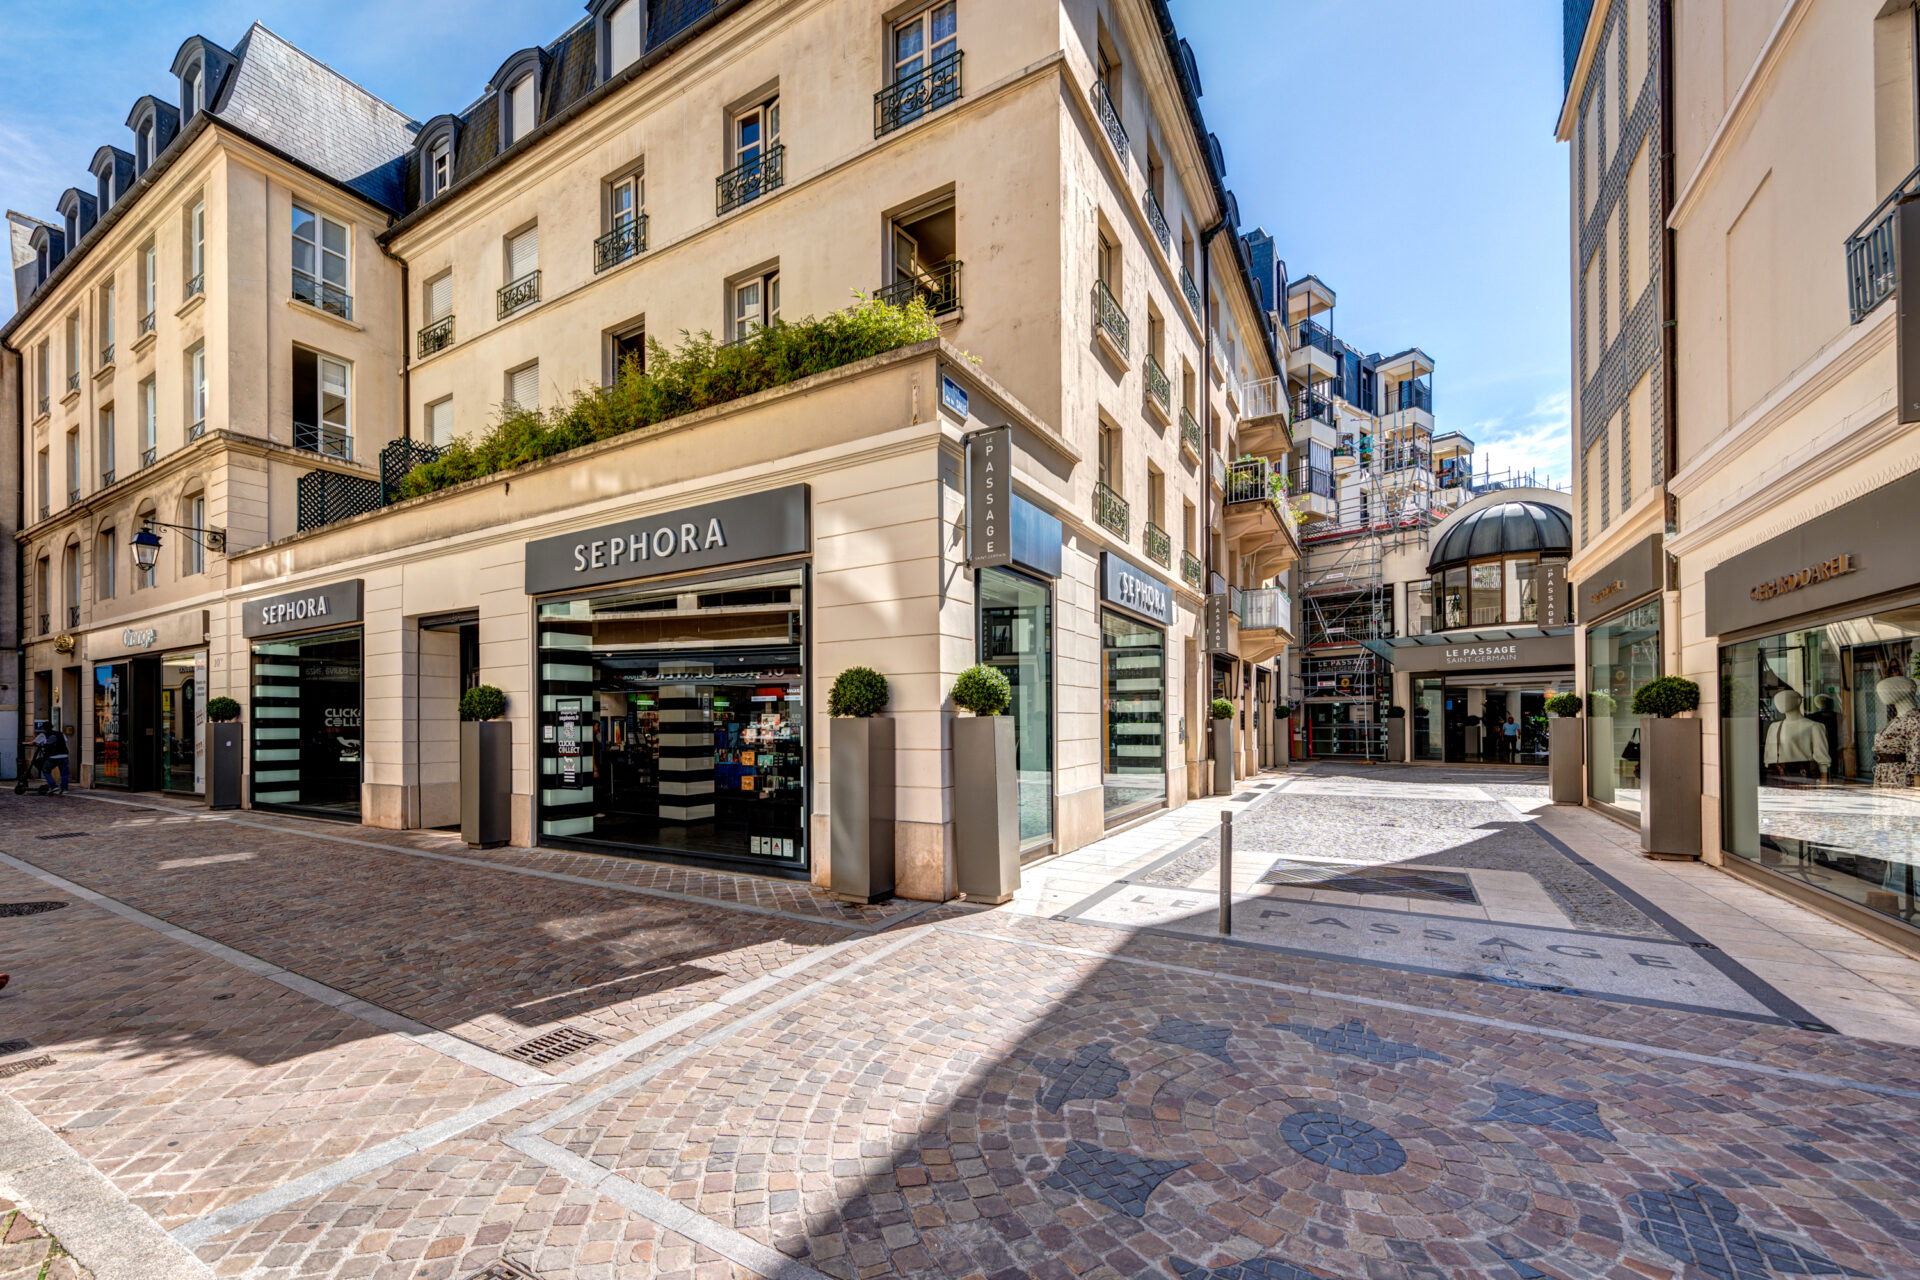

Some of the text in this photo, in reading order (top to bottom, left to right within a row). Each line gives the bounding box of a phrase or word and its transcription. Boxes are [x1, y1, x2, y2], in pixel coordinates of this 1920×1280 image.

[986, 445, 994, 553] PASSAGE
[574, 517, 727, 572] SEPHORA
[262, 595, 327, 625] SEPHORA
[1120, 571, 1167, 613] SEPHORA
[1446, 645, 1517, 657] LE PASSAGE
[1446, 654, 1518, 664] SAINT-GERMAIN
[325, 718, 361, 727] COLLE
[1131, 895, 1678, 970] LE PASSAGE
